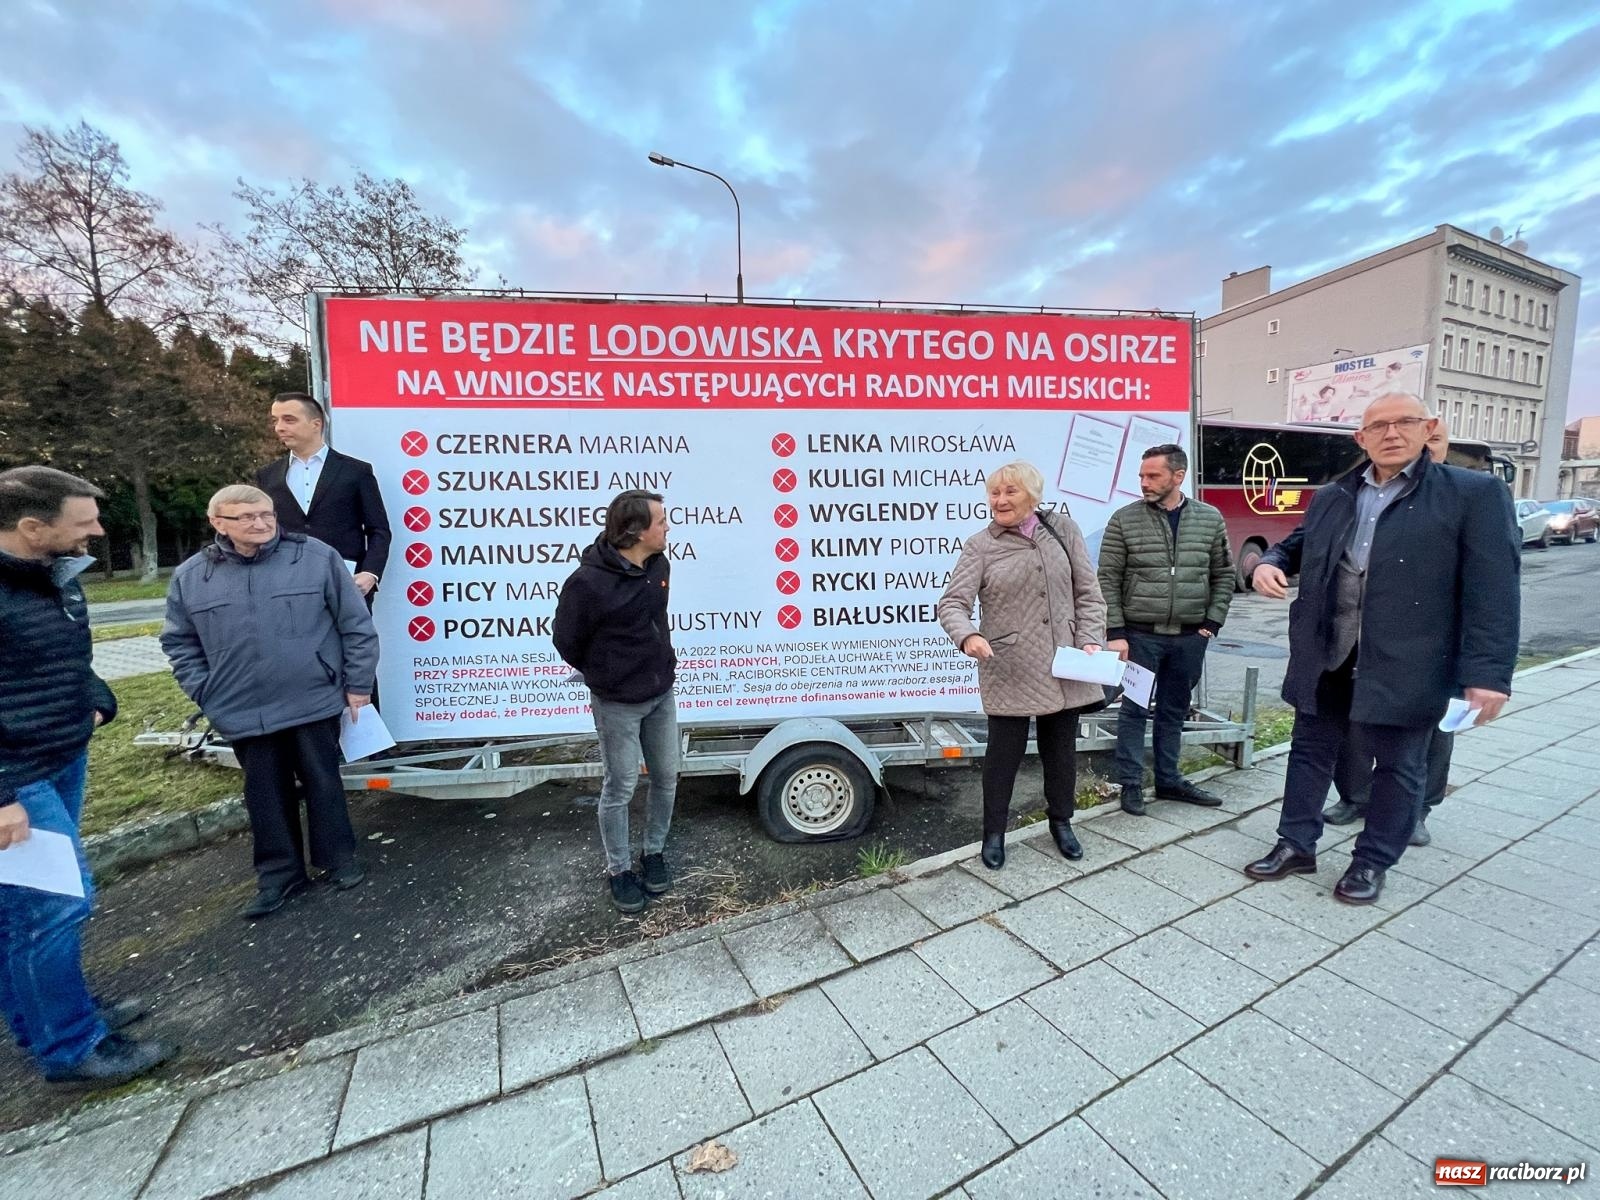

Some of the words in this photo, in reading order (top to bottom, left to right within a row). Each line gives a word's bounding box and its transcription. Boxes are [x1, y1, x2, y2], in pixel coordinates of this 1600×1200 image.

[359, 320, 428, 354] NIE
[442, 321, 575, 362] BĘDZIE
[588, 324, 822, 358] LODOWISKA
[833, 328, 995, 361] KRYTEGO
[1006, 331, 1055, 362] NA
[1064, 333, 1177, 364] OSIRZE
[1335, 357, 1376, 374] HOSTEL
[397, 369, 446, 396] NA
[454, 370, 604, 397] WNIOSEK
[613, 371, 856, 403] NASTĘPUJĄCYCH
[866, 374, 998, 399] RADNYCH
[1008, 376, 1151, 400] MIEJSKICH:
[436, 434, 573, 455] CZERNERA
[579, 434, 690, 454] MARIANA
[807, 434, 882, 453] LENKA
[890, 434, 1016, 453] MIROSŁAWA
[437, 470, 600, 492] SZUKALSKIEJ
[608, 471, 673, 490] ANNY
[808, 468, 884, 488] KULIGI
[893, 468, 986, 487] MICHAŁA
[439, 506, 608, 529] SZUKALSKIEG
[809, 502, 938, 523] WYGLENDY
[441, 543, 582, 566] MAINUSZA
[811, 537, 883, 558] KLIMY
[891, 537, 963, 556] PIOTRA
[442, 581, 497, 602] FICY
[812, 572, 875, 592] RYCKI
[885, 571, 952, 590] PAWŁA
[669, 610, 762, 631] JUSTYNY
[813, 604, 938, 627] BIAŁUSKIEJ
[414, 656, 450, 667] RADA
[452, 655, 498, 666] MIASTA
[501, 653, 519, 664] NA
[521, 652, 555, 663] SESJI
[690, 646, 717, 656] 2022
[720, 645, 753, 655] ROKU
[757, 644, 773, 653] NA
[775, 641, 829, 652] WNIOSEK
[832, 637, 920, 650] WYMIENIONYCH
[414, 670, 448, 680] PRZY
[452, 666, 530, 679] SPRZECIWIE
[721, 656, 781, 668] RADNYCH,
[896, 651, 907, 660] W
[414, 681, 509, 694] WSTRZYMANIA
[811, 665, 866, 677] CENTRUM
[869, 662, 929, 674] AKTYWNEJ
[415, 695, 499, 708] SPOŁECZNEJ
[510, 692, 566, 703] BUDOWA
[743, 683, 772, 693] Sesja
[775, 682, 788, 691] do
[791, 679, 843, 692] obejrzenia
[845, 680, 858, 688] na
[416, 710, 456, 722] Należy
[460, 708, 500, 720] dodać,
[504, 707, 517, 717] że
[521, 705, 579, 717] Prezydent
[679, 701, 692, 709] na
[696, 699, 713, 708] ten
[717, 697, 732, 707] cel
[736, 695, 798, 706] zewnętrzne
[801, 689, 885, 702] dofinansowanie
[900, 688, 936, 698] kwocie
[940, 687, 945, 695] 4
